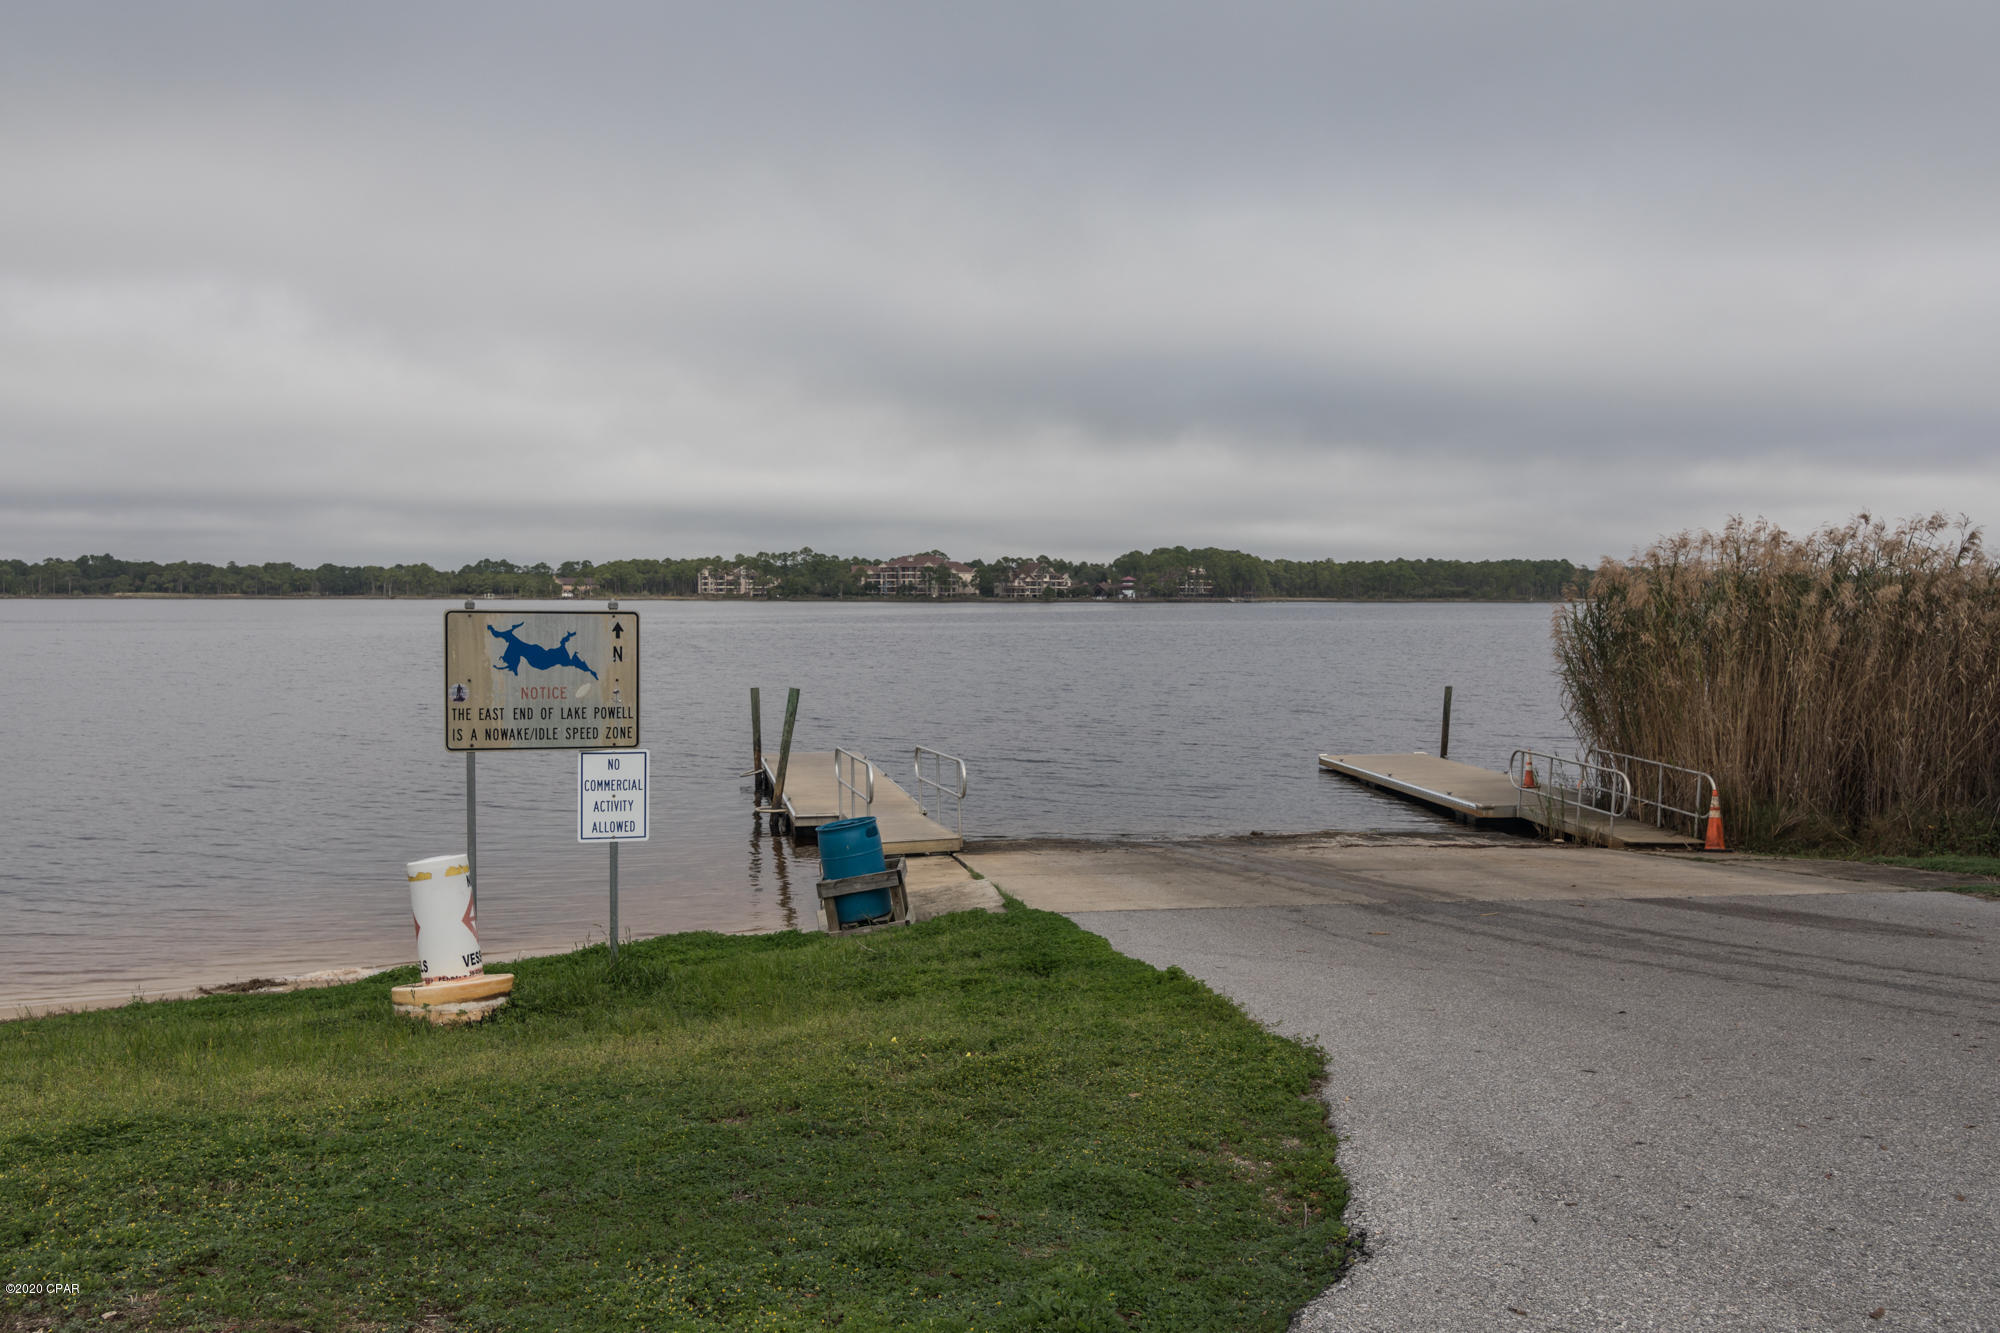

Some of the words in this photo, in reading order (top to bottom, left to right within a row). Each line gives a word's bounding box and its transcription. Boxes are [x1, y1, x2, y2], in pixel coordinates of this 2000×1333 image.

[613, 646, 623, 662] N
[521, 687, 568, 700] NOTICE
[451, 708, 471, 721] THE
[478, 707, 505, 721] EAST
[513, 707, 533, 720] END
[540, 707, 554, 720] OF
[560, 707, 587, 720] LAKE
[594, 706, 634, 719] POWELL
[452, 728, 463, 742] IS
[470, 728, 478, 741] A
[484, 727, 558, 741] NOWAKE/IDLE
[565, 727, 599, 740] SPEED
[605, 726, 633, 740] ZONE
[607, 758, 620, 771] NO
[584, 779, 643, 792] COMMERCIAL
[593, 800, 634, 812] ACTIVITY
[591, 820, 636, 834] ALLOWED
